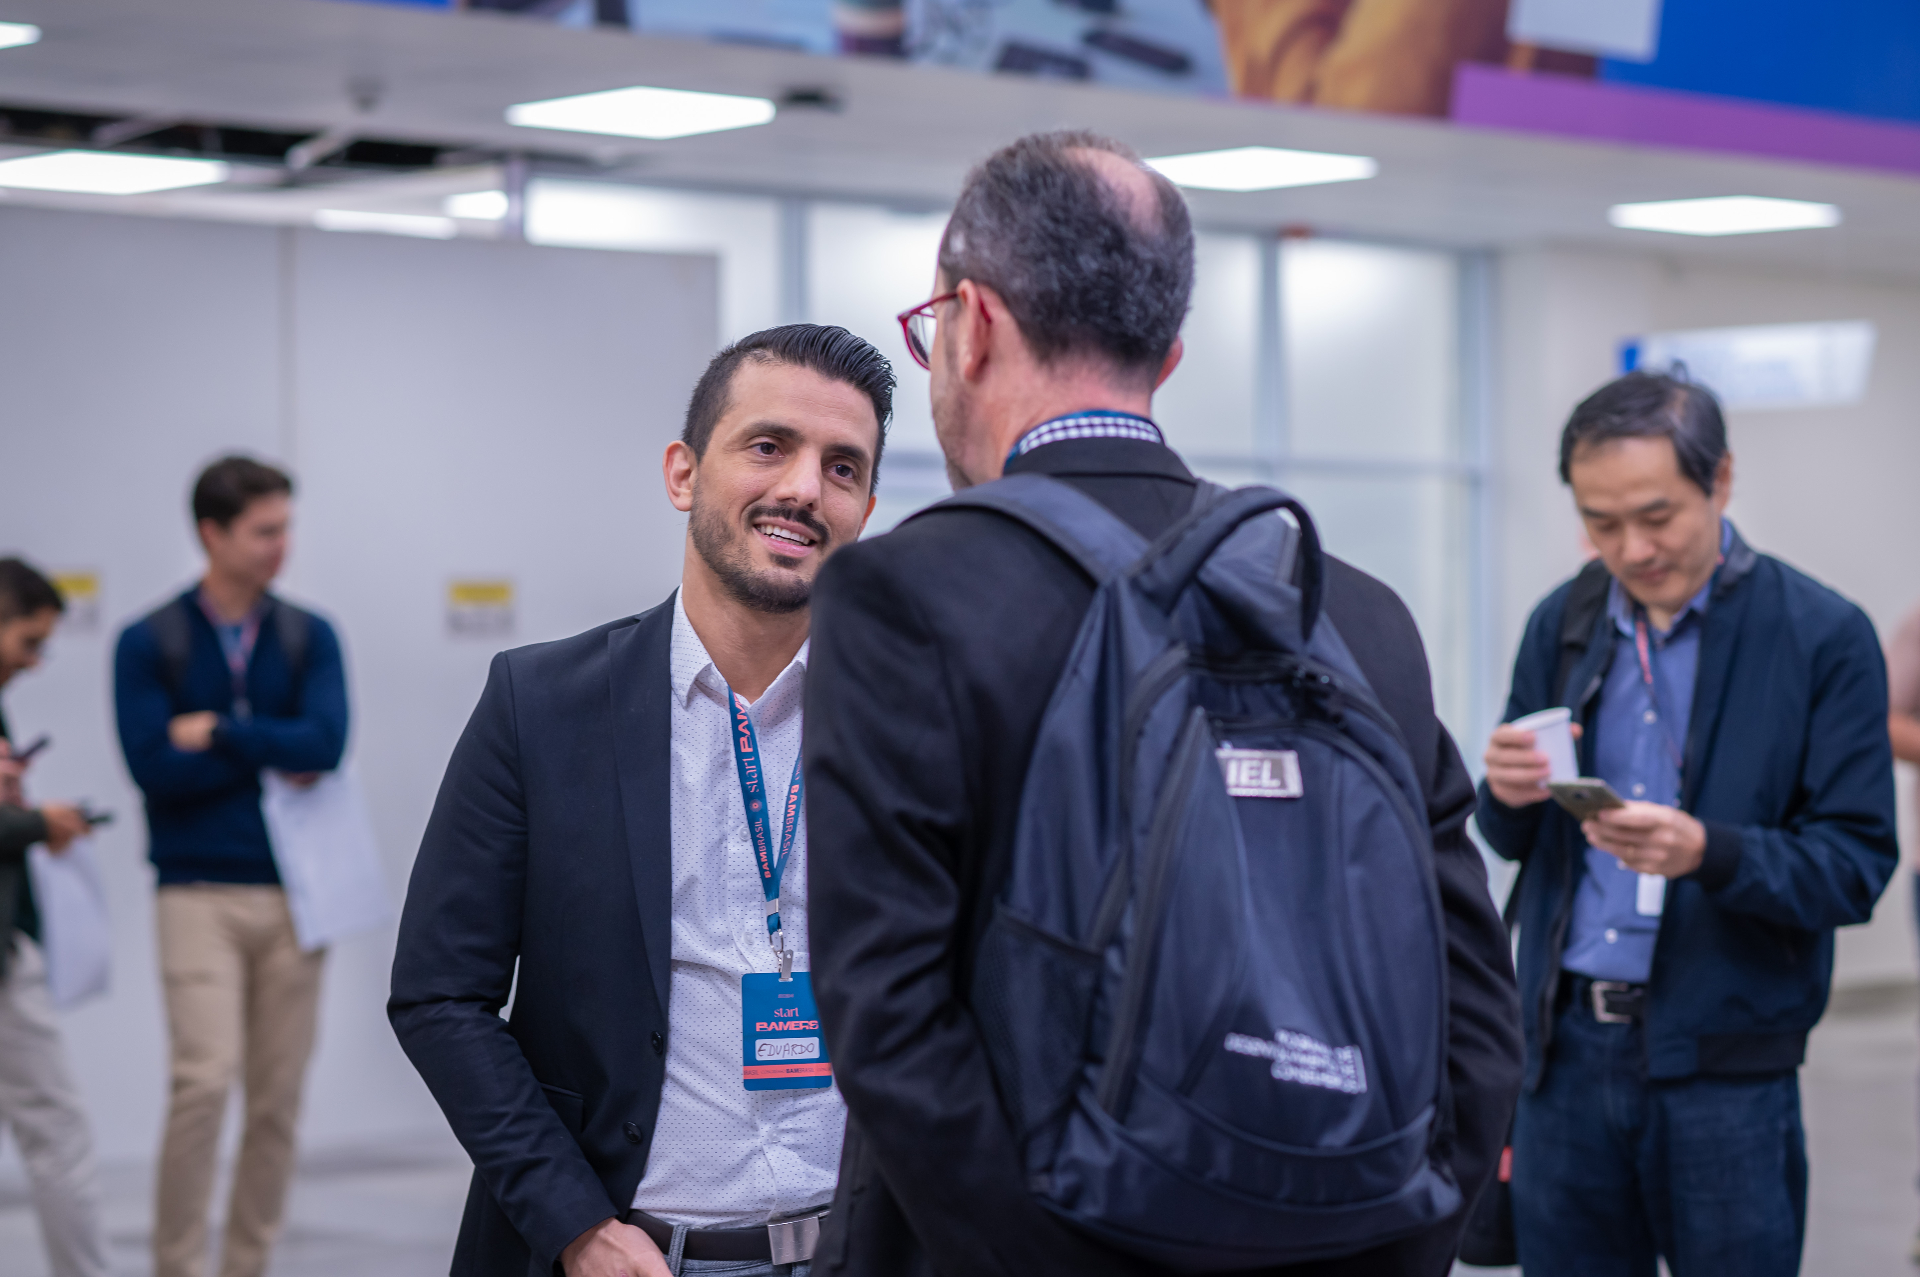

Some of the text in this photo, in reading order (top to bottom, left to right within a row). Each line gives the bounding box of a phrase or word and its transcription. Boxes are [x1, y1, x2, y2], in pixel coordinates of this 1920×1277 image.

[732, 692, 760, 793] start BAM
[780, 784, 800, 859] BAMBRASIL
[754, 817, 772, 879] BAMBRASIL
[755, 1020, 819, 1032] BAMERS
[773, 1007, 799, 1018] start
[757, 1042, 815, 1058] EDUARDO
